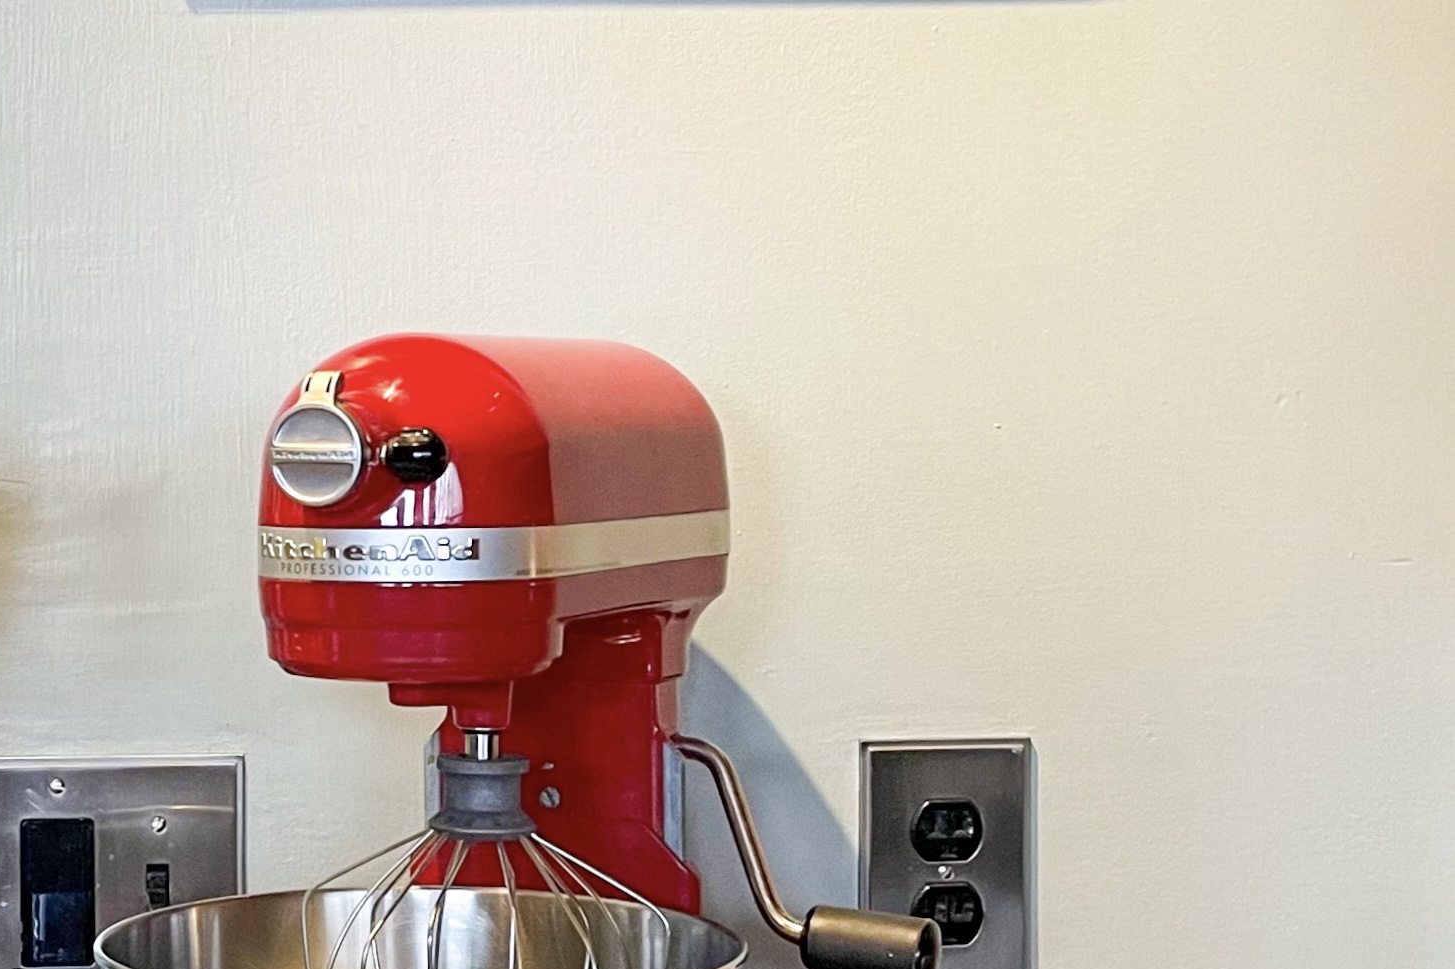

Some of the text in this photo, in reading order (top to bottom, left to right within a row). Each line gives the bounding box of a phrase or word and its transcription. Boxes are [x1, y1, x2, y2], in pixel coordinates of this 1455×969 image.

[261, 532, 480, 561] KitchenAid
[280, 562, 434, 576] PROFESSIONAL 600
